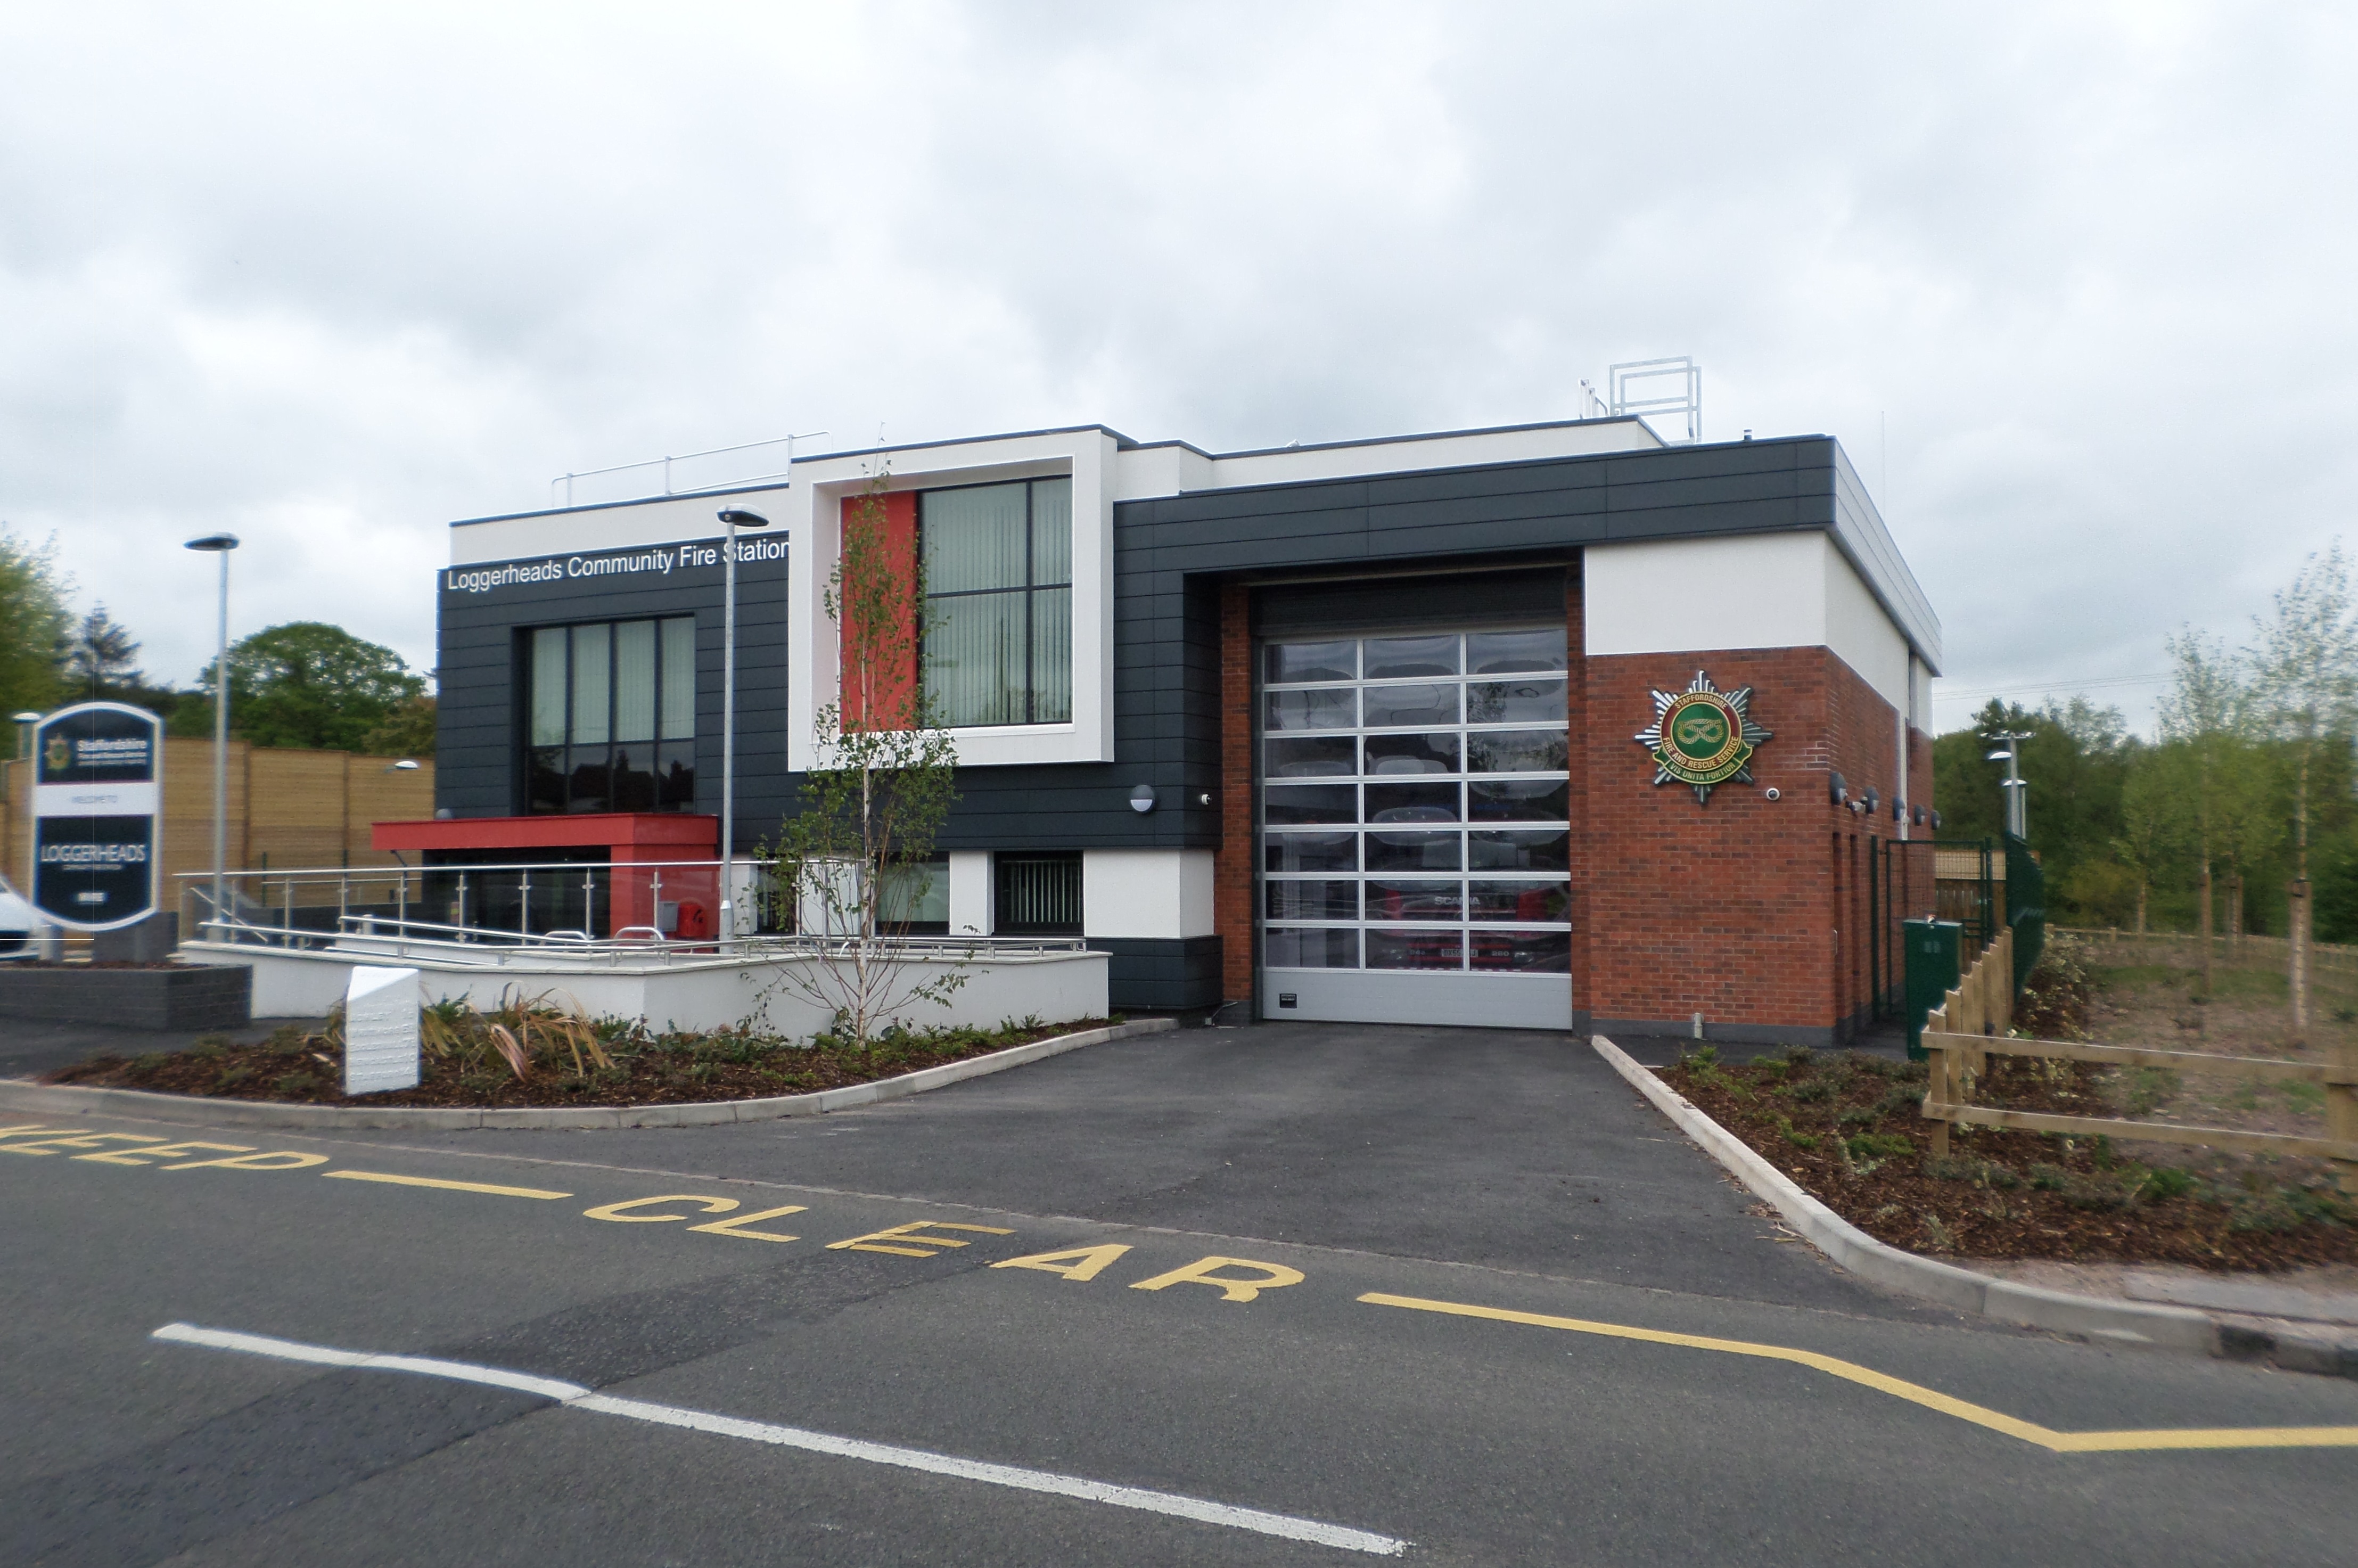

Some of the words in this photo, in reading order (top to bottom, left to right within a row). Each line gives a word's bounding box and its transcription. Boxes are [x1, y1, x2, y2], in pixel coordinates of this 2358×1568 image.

[448, 562, 561, 592] Loggerheads
[568, 548, 674, 574] Community
[680, 545, 716, 568] Fire
[1675, 694, 1728, 710] STAFFORDSHIRE
[1663, 737, 1674, 753] FIRE
[1673, 753, 1687, 765] AND
[1688, 759, 1717, 769] RESCUE
[1717, 736, 1739, 763] SERVICE
[1670, 763, 1681, 774] VIS
[1682, 771, 1704, 781] UNITA
[1706, 762, 1736, 780] FORTIOR
[41, 845, 145, 861] LOGGERHEADS
[584, 1195, 1305, 1302] CLEAR
